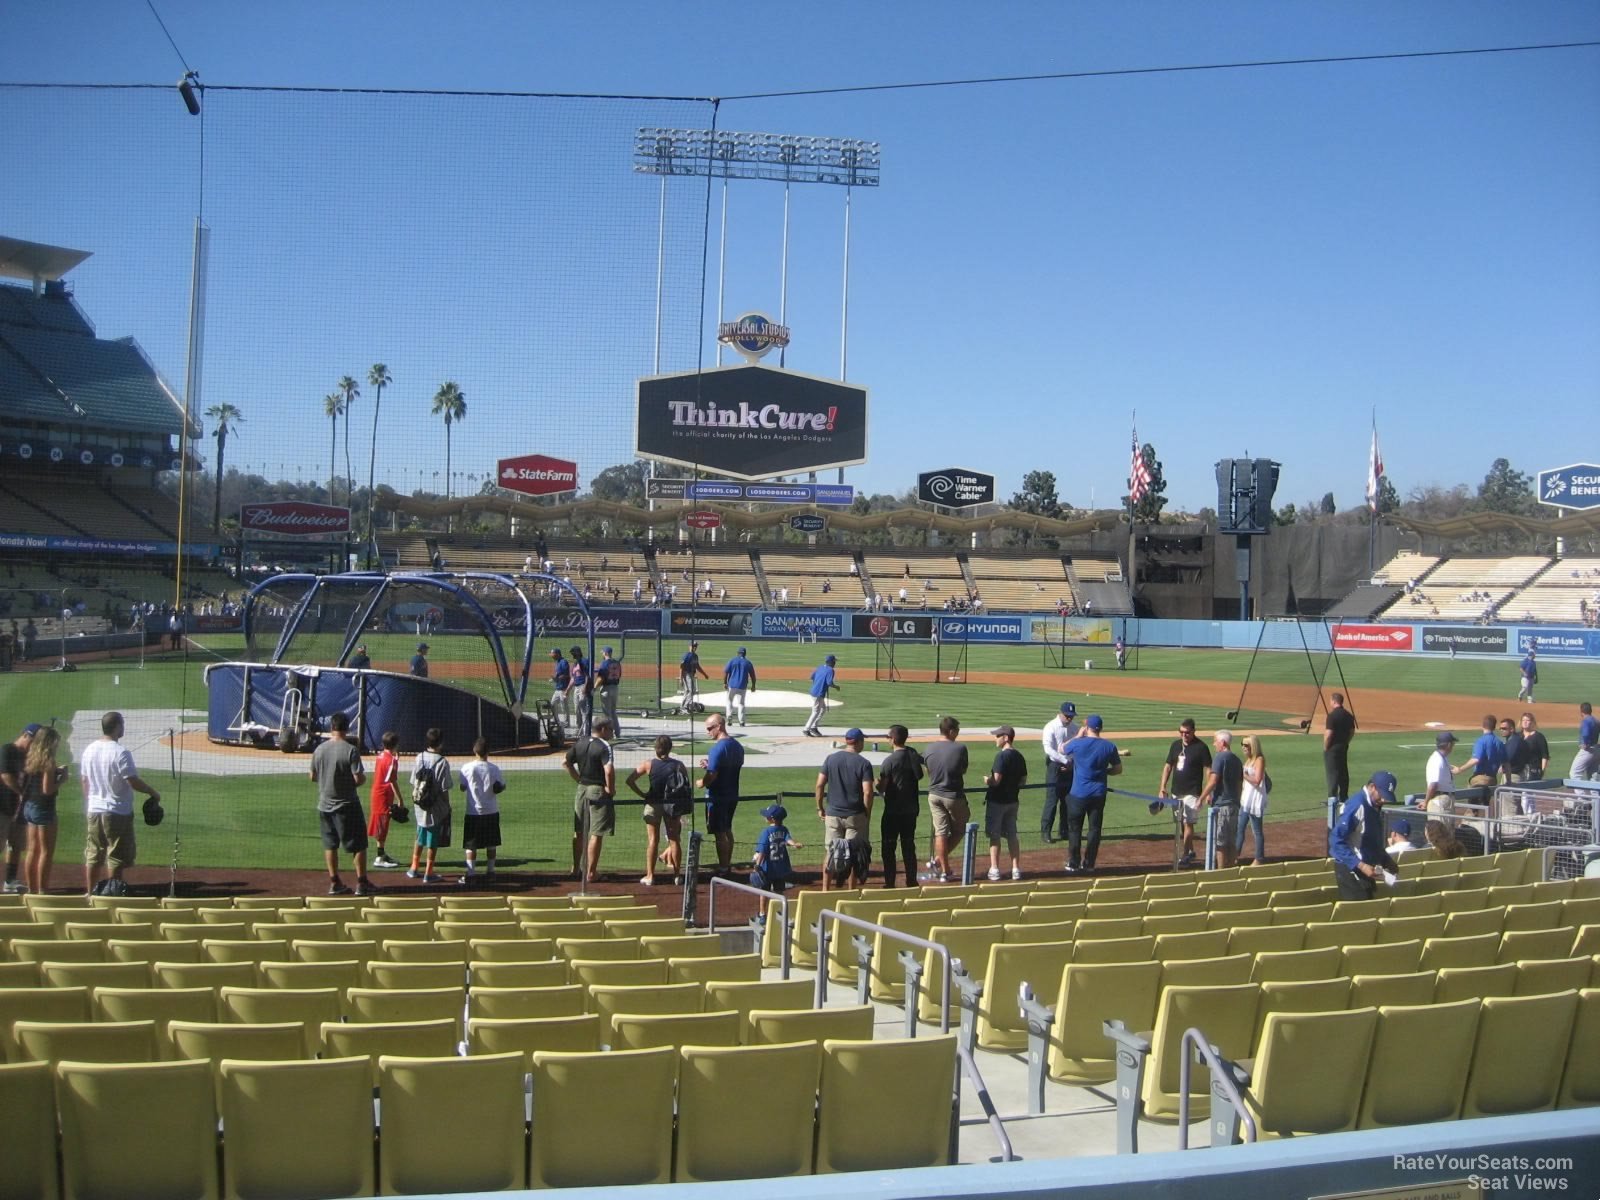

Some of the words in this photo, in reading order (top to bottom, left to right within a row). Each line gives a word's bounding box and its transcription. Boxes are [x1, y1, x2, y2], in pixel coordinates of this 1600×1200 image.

[720, 321, 760, 336] UNIVERSAL
[761, 322, 790, 339] STUDIOS
[729, 335, 781, 344] HOLLYWOOD
[668, 400, 837, 431] ThinkCure!
[686, 430, 710, 438] official
[712, 431, 736, 440] charity
[773, 434, 800, 442] Angeles
[955, 475, 977, 484] Time
[954, 483, 987, 492] Warner
[954, 492, 980, 500] Cable
[246, 508, 347, 526] Budweiser
[0, 537, 25, 546] onate
[26, 537, 48, 547] Now!
[514, 614, 562, 632] Ageles
[764, 616, 786, 626] SAN
[795, 617, 840, 627] MANUEL
[893, 620, 916, 634] LG
[967, 623, 1020, 634] HYUNDAI
[1353, 633, 1360, 641] of
[1360, 633, 1390, 642] America
[1434, 634, 1453, 643] Time
[1453, 635, 1481, 644] Warner
[1482, 636, 1504, 644] Cable
[1561, 637, 1584, 646] Lynch
[1441, 1191, 1461, 1200] BALLS
